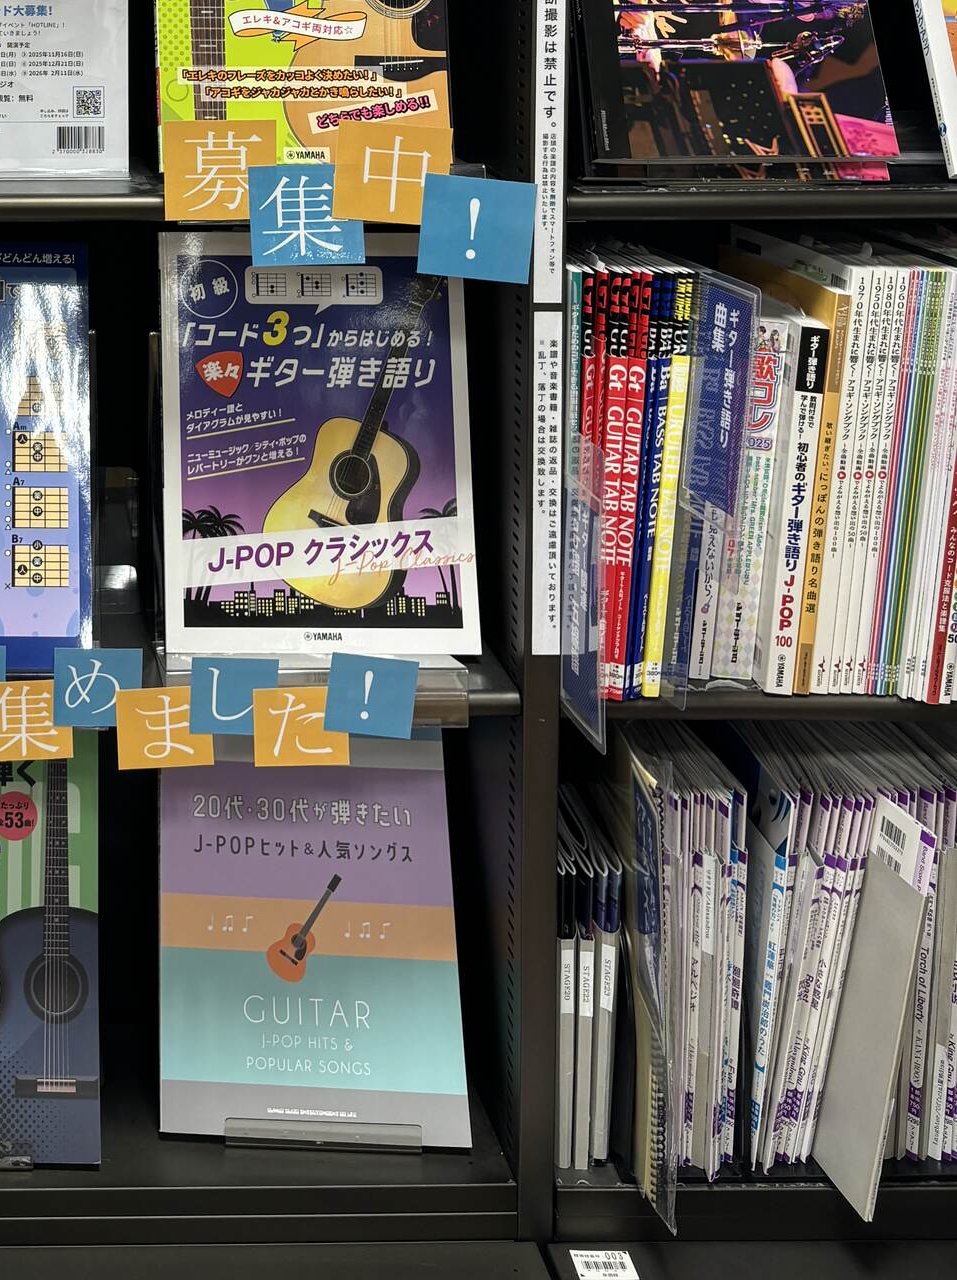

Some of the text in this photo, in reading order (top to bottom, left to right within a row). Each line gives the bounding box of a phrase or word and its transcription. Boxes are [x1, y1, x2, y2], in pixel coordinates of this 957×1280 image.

[18, 94, 34, 102] 無料
[295, 150, 326, 160] YAMAHA
[202, 357, 437, 390] 楽々 ギター弾き語り
[605, 406, 625, 475] GUITAR
[208, 529, 434, 573] J-POP クラシックス
[313, 632, 343, 642] YAMAHA
[0, 801, 30, 811] たっぷり
[193, 836, 413, 863] J-POPヒット&人気ソングス
[562, 962, 572, 1001] STAGE20
[243, 994, 371, 1030] GUITAR
[260, 1034, 338, 1051] J-POP HITS
[246, 1056, 372, 1076] POPULAR SONGS
